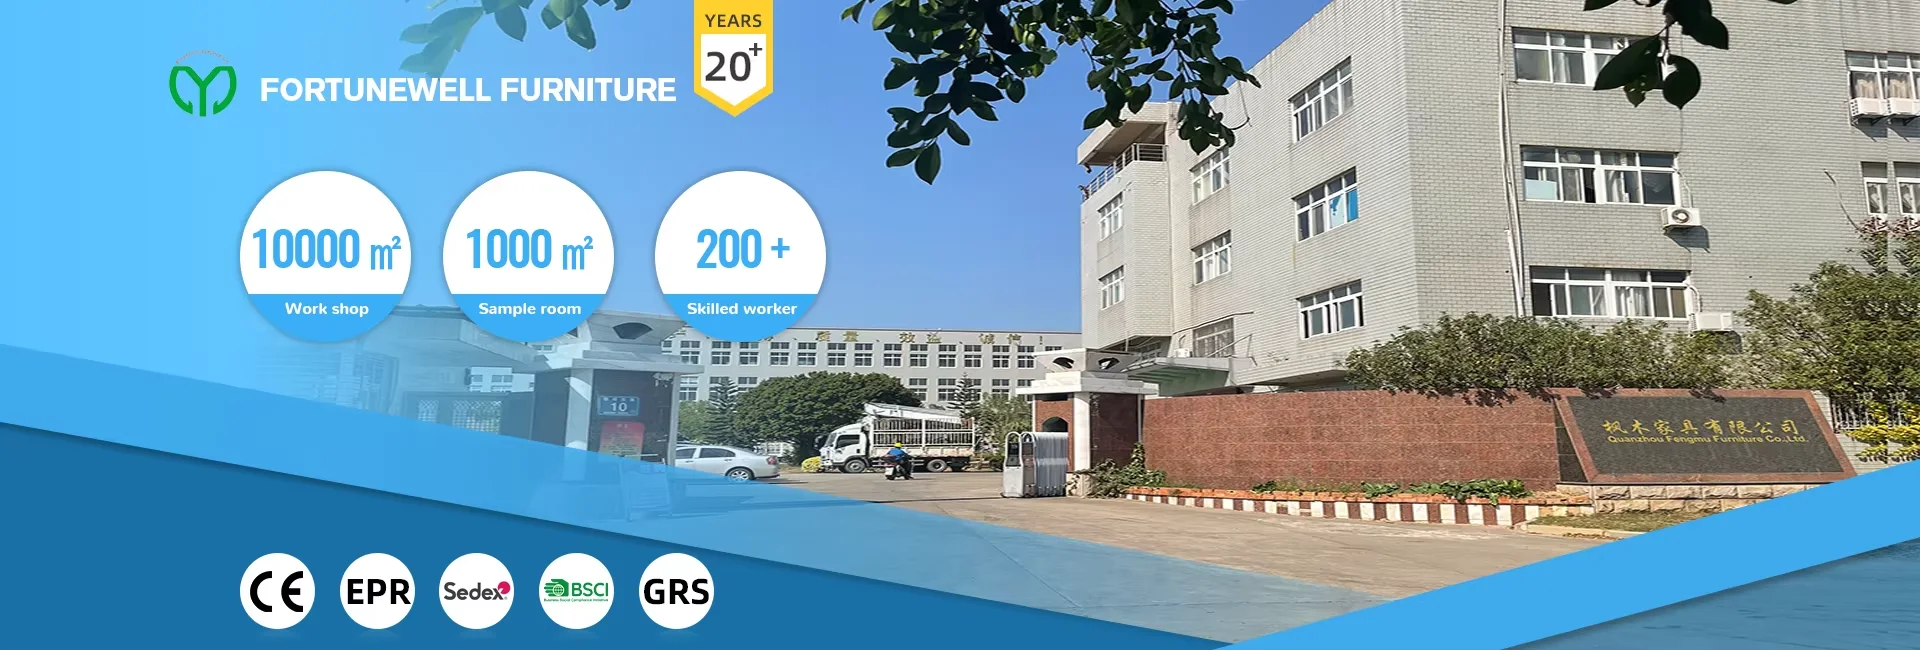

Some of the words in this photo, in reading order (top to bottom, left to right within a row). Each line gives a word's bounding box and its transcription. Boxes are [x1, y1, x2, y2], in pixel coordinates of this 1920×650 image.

[610, 402, 628, 412] 10
[1607, 435, 1665, 443] Quanzhou
[1666, 435, 1711, 444] Fengmu
[1712, 435, 1763, 443] Furniture
